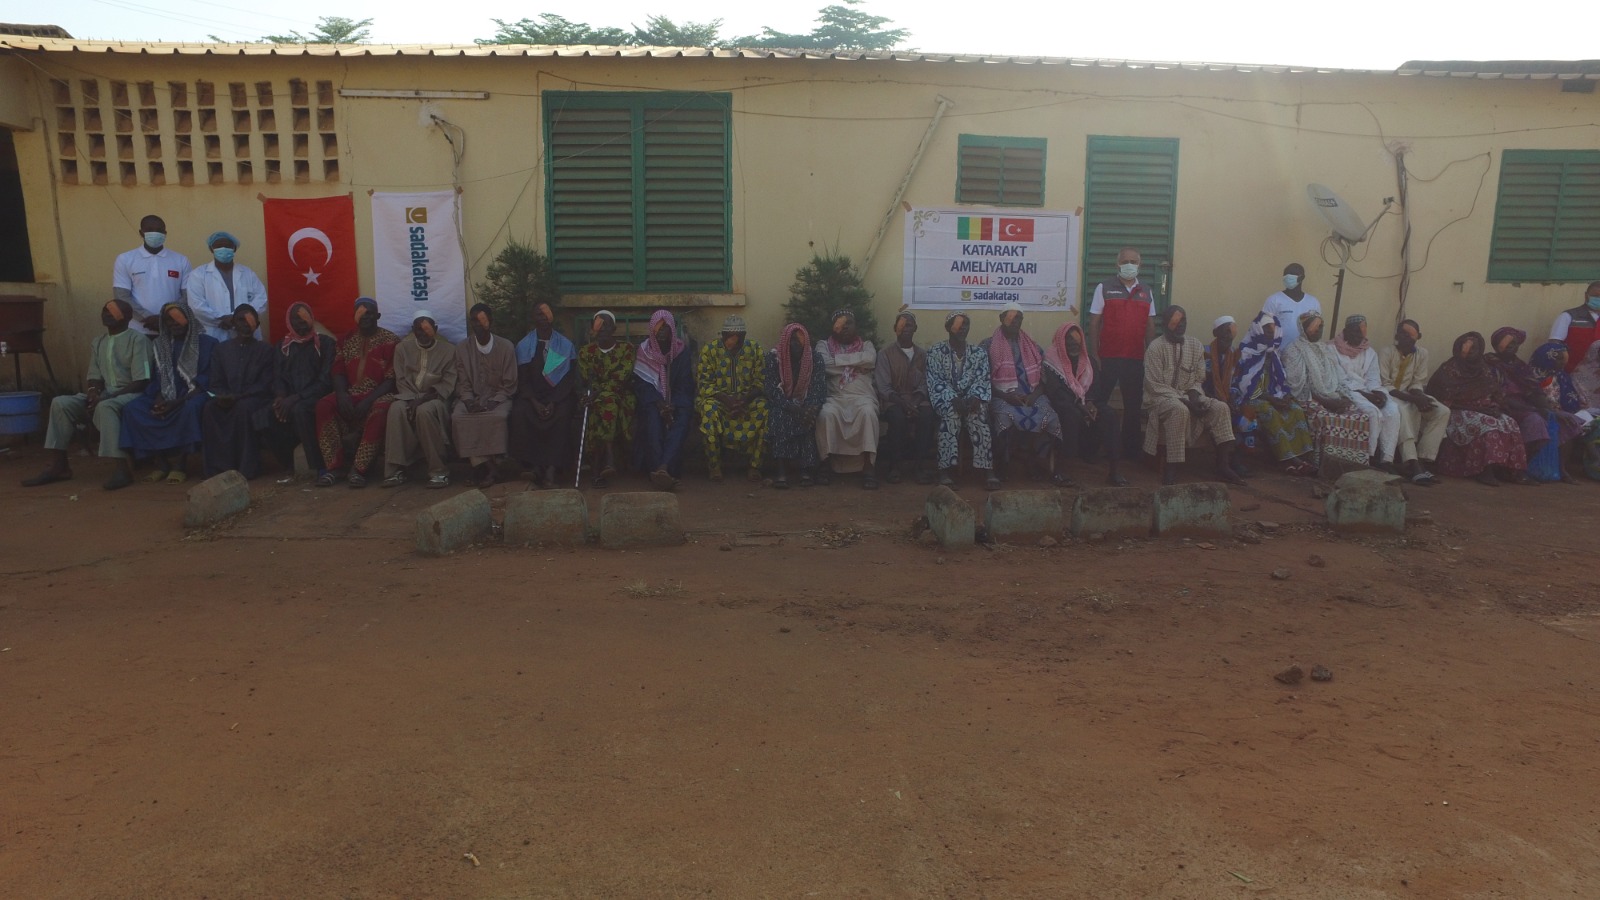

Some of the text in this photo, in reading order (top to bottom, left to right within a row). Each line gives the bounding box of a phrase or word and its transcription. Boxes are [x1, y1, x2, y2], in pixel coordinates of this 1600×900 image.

[962, 244, 1027, 257] KATARAKT
[409, 226, 430, 301] sadakataşı
[950, 259, 1037, 274] AMELİYATLARI
[961, 274, 989, 285] MALİ
[997, 276, 1024, 286] 2020
[973, 290, 1020, 302] sadakataşı
